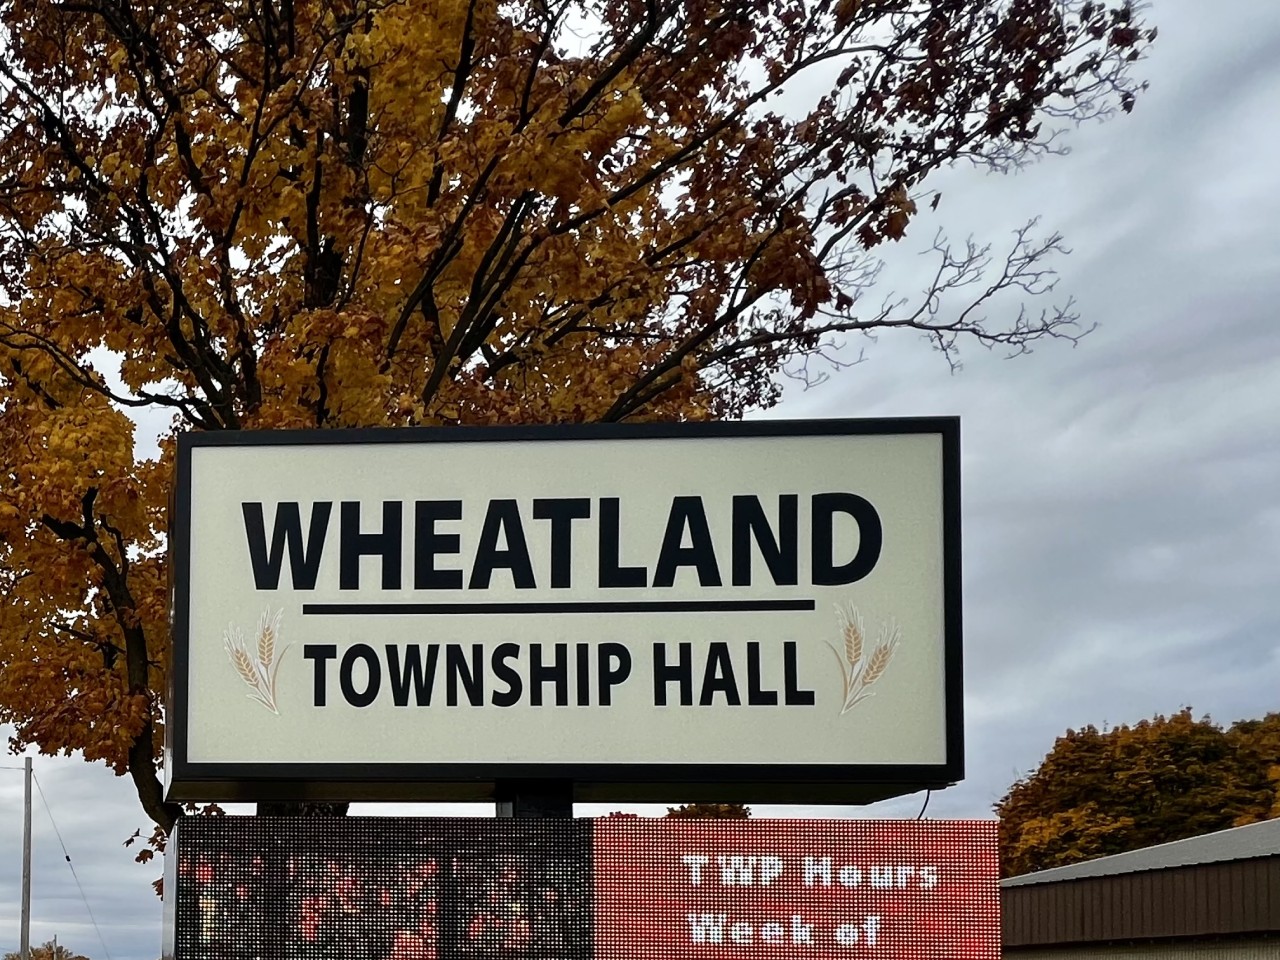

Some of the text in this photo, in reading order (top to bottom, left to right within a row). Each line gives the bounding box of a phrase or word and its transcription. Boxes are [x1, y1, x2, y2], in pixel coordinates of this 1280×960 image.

[242, 492, 883, 590] WHEATLAND
[304, 641, 815, 708] TOWNSHIP HALL
[683, 855, 938, 890] TWP Hours
[688, 913, 881, 946] Week of
